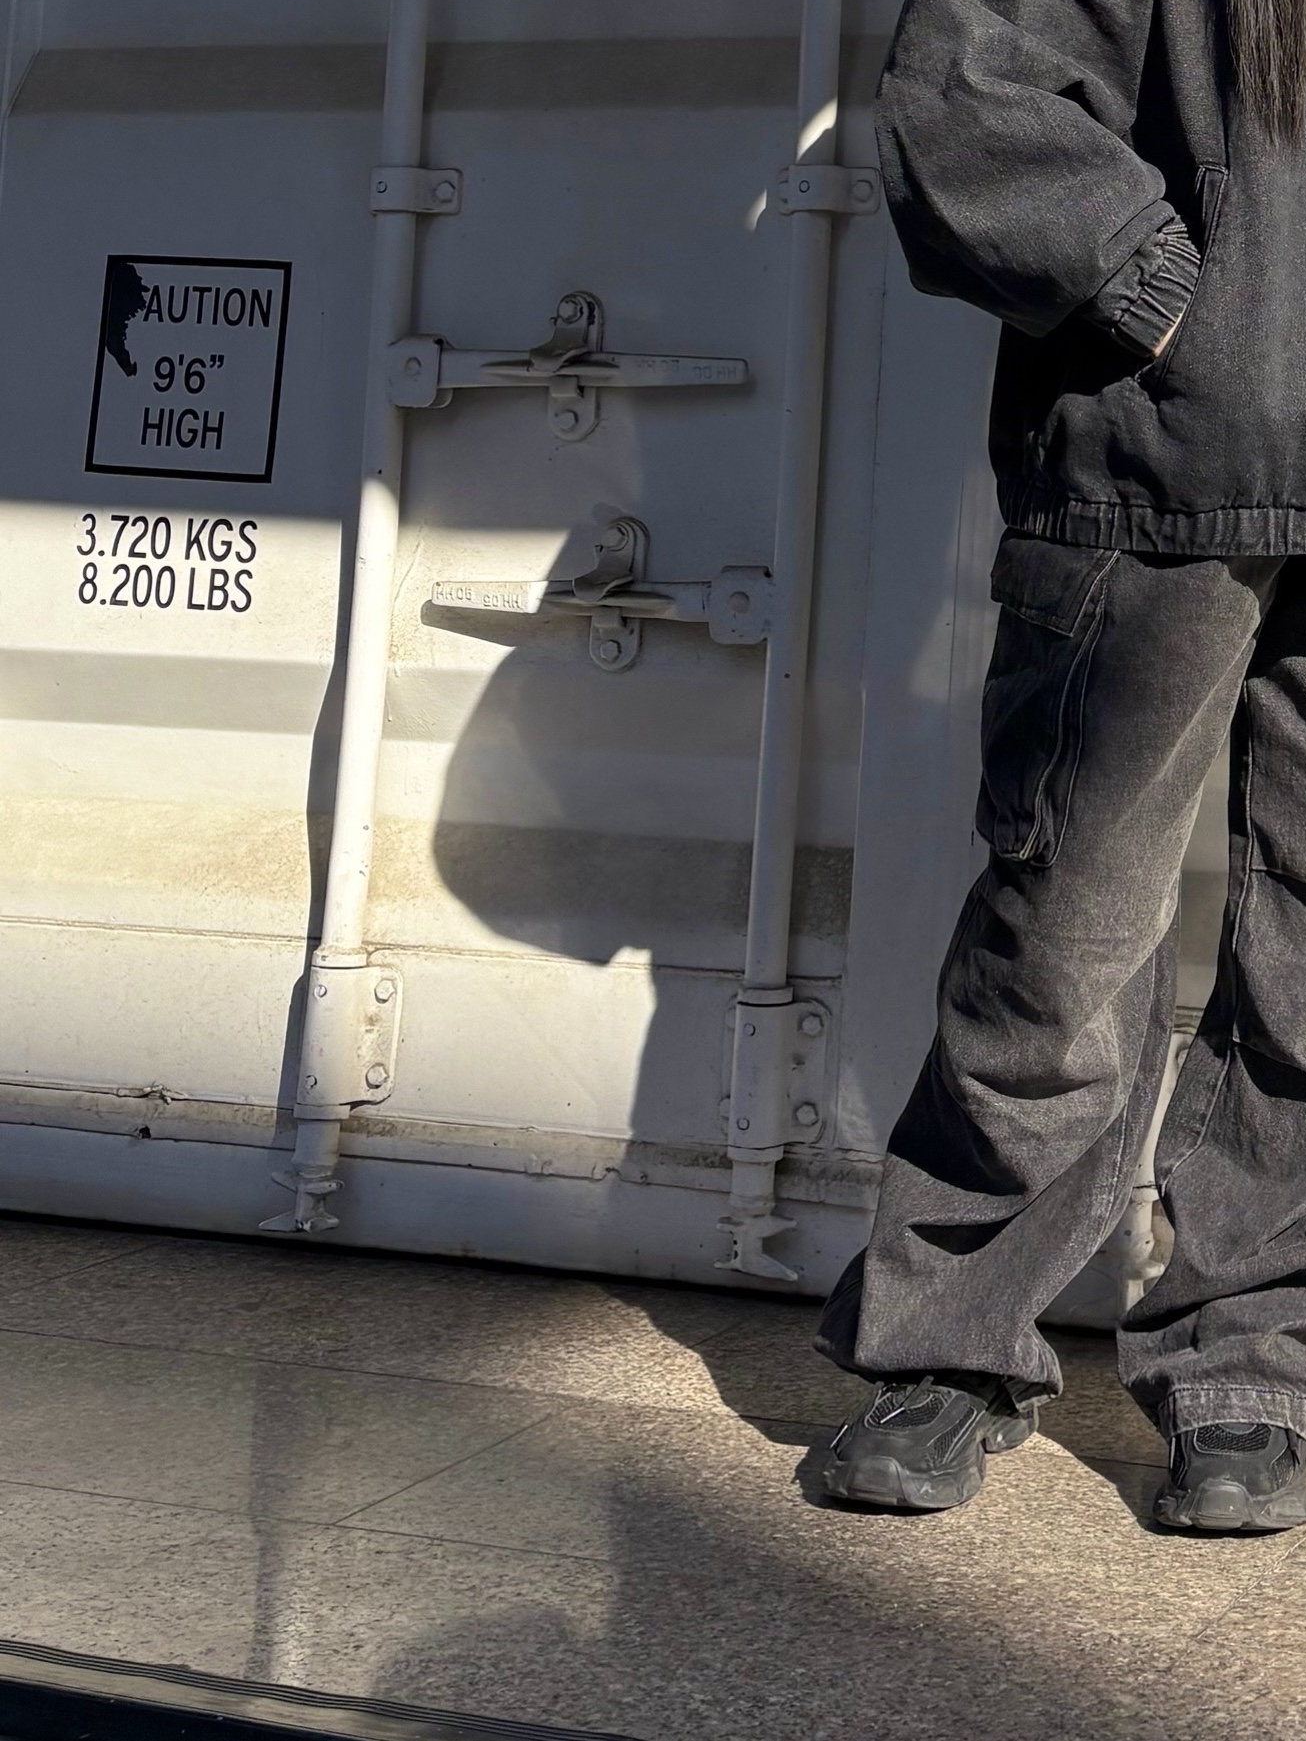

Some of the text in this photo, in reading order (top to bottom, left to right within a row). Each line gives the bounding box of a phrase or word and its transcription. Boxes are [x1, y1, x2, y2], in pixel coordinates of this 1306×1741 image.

[143, 284, 273, 328] AUTION
[141, 407, 225, 450] HIGH
[77, 513, 258, 564] 3.720 KGS
[78, 562, 254, 613] 8.200 LBS
